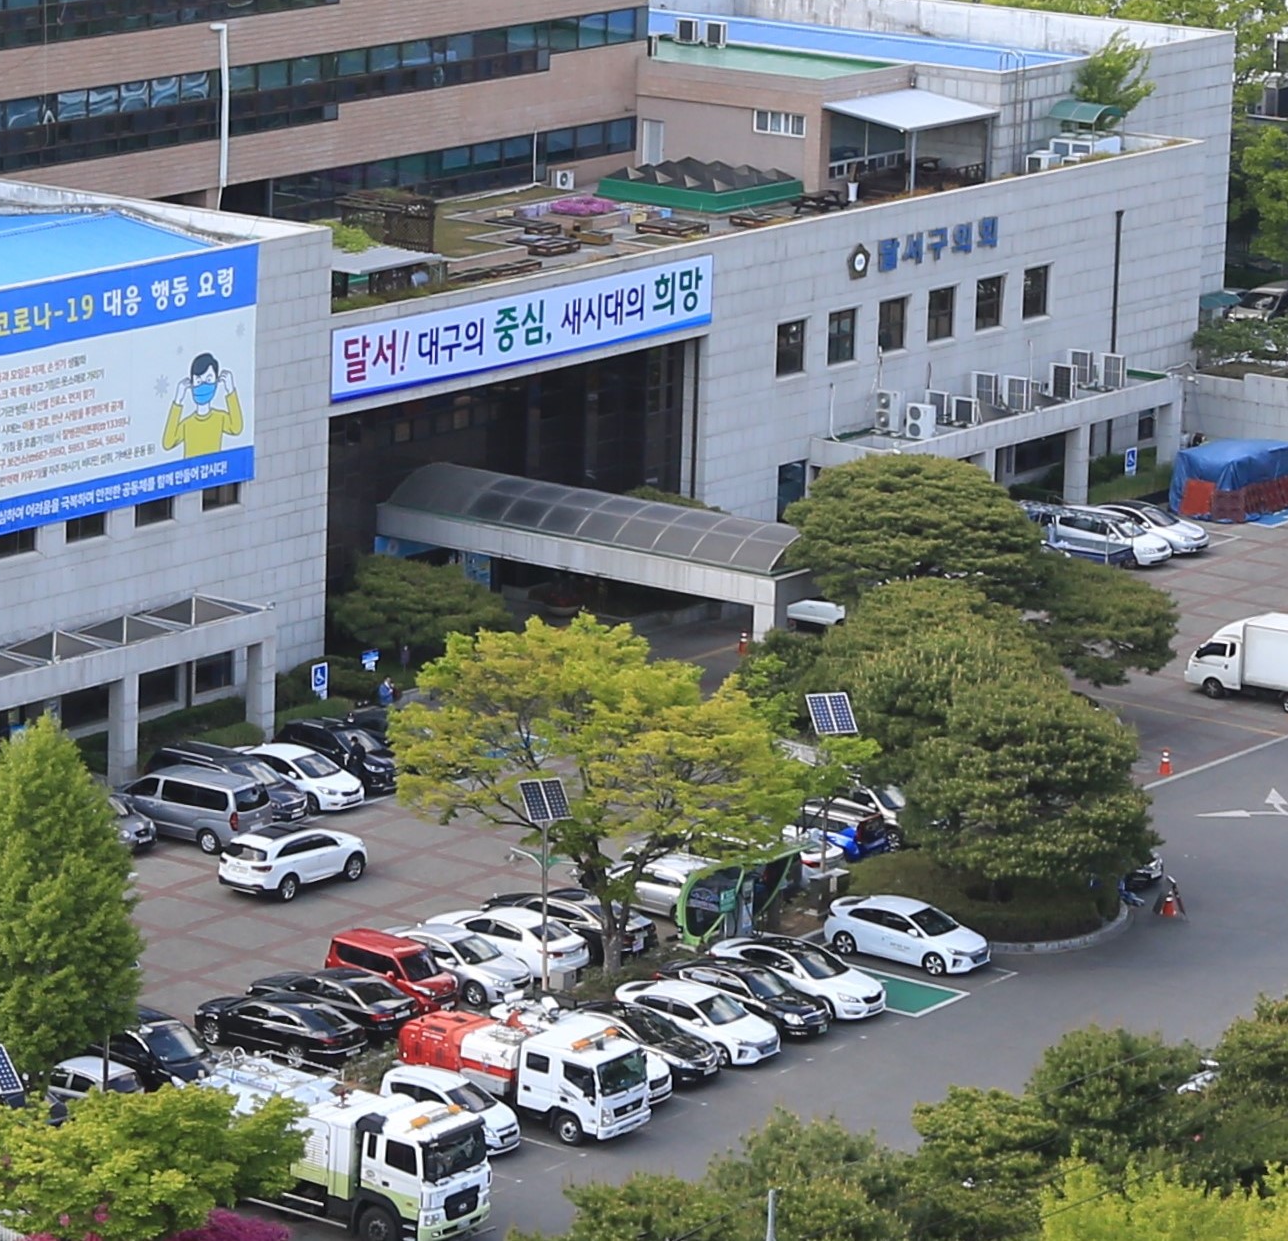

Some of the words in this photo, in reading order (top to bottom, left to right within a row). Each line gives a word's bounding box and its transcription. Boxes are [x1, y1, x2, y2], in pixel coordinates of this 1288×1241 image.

[879, 216, 998, 273] 달서구의회
[103, 285, 142, 317] 대응
[151, 276, 189, 310] 행동
[197, 267, 234, 298] 요령
[344, 329, 409, 384] 달서!
[418, 318, 484, 365] 대구의
[493, 300, 552, 353] 중심,
[560, 284, 645, 335] 새시대의
[653, 267, 704, 315] 희망
[96, 484, 122, 504] 안전한
[122, 476, 156, 498] 공동체를
